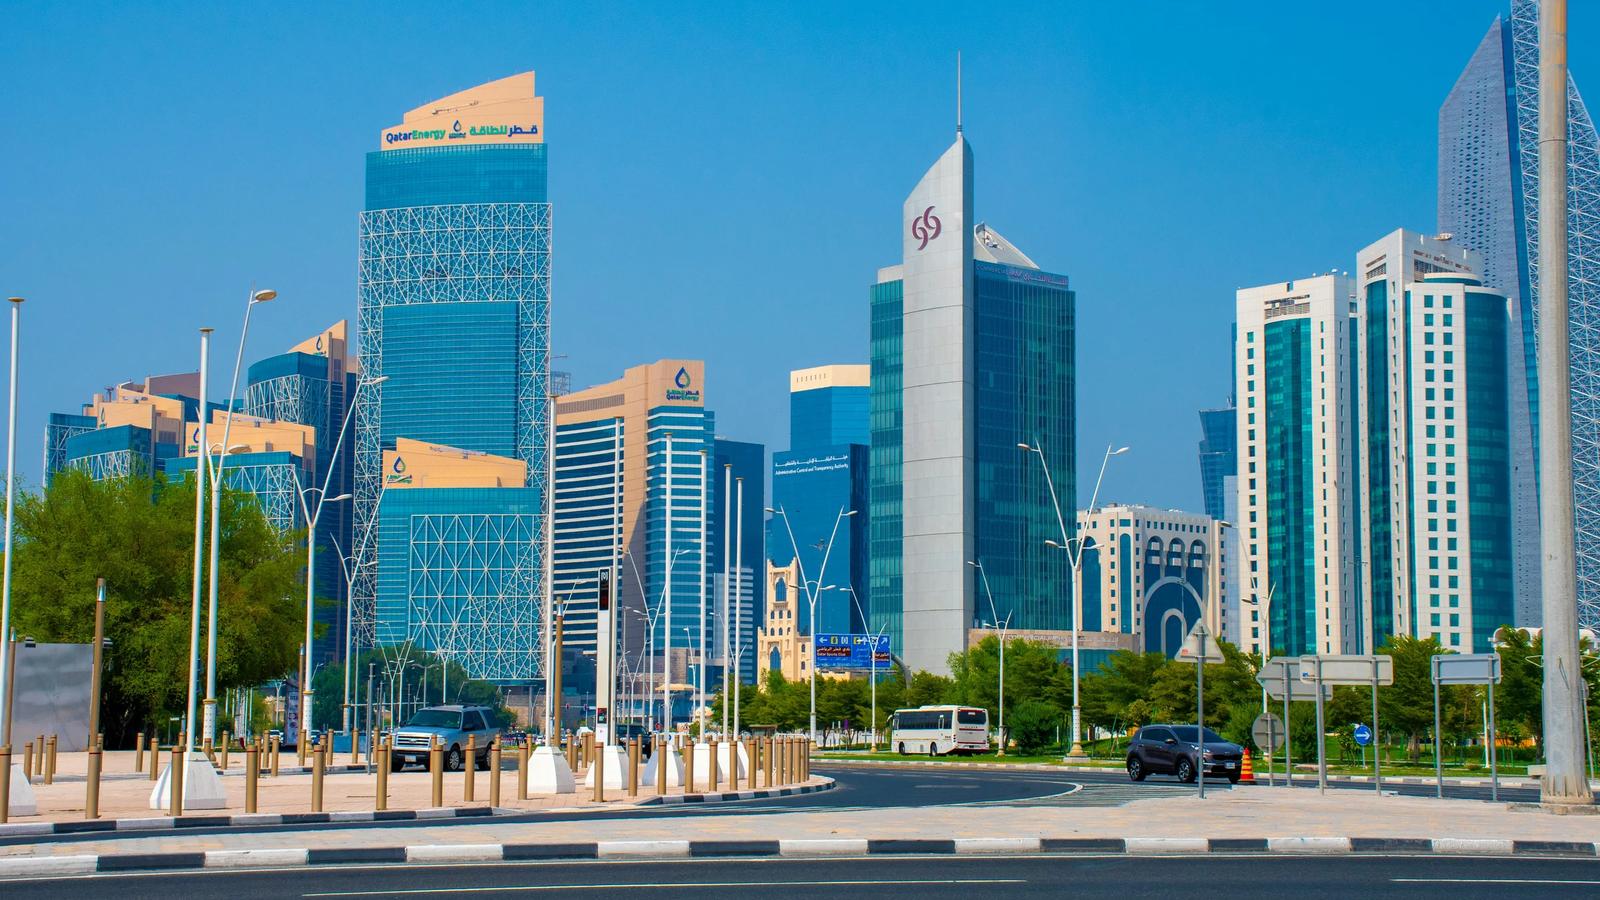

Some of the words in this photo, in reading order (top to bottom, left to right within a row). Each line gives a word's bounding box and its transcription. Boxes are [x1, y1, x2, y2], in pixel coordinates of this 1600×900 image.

[386, 129, 446, 142] QatarEnergy
[469, 125, 507, 136] للطاقة
[508, 125, 538, 137] قطر
